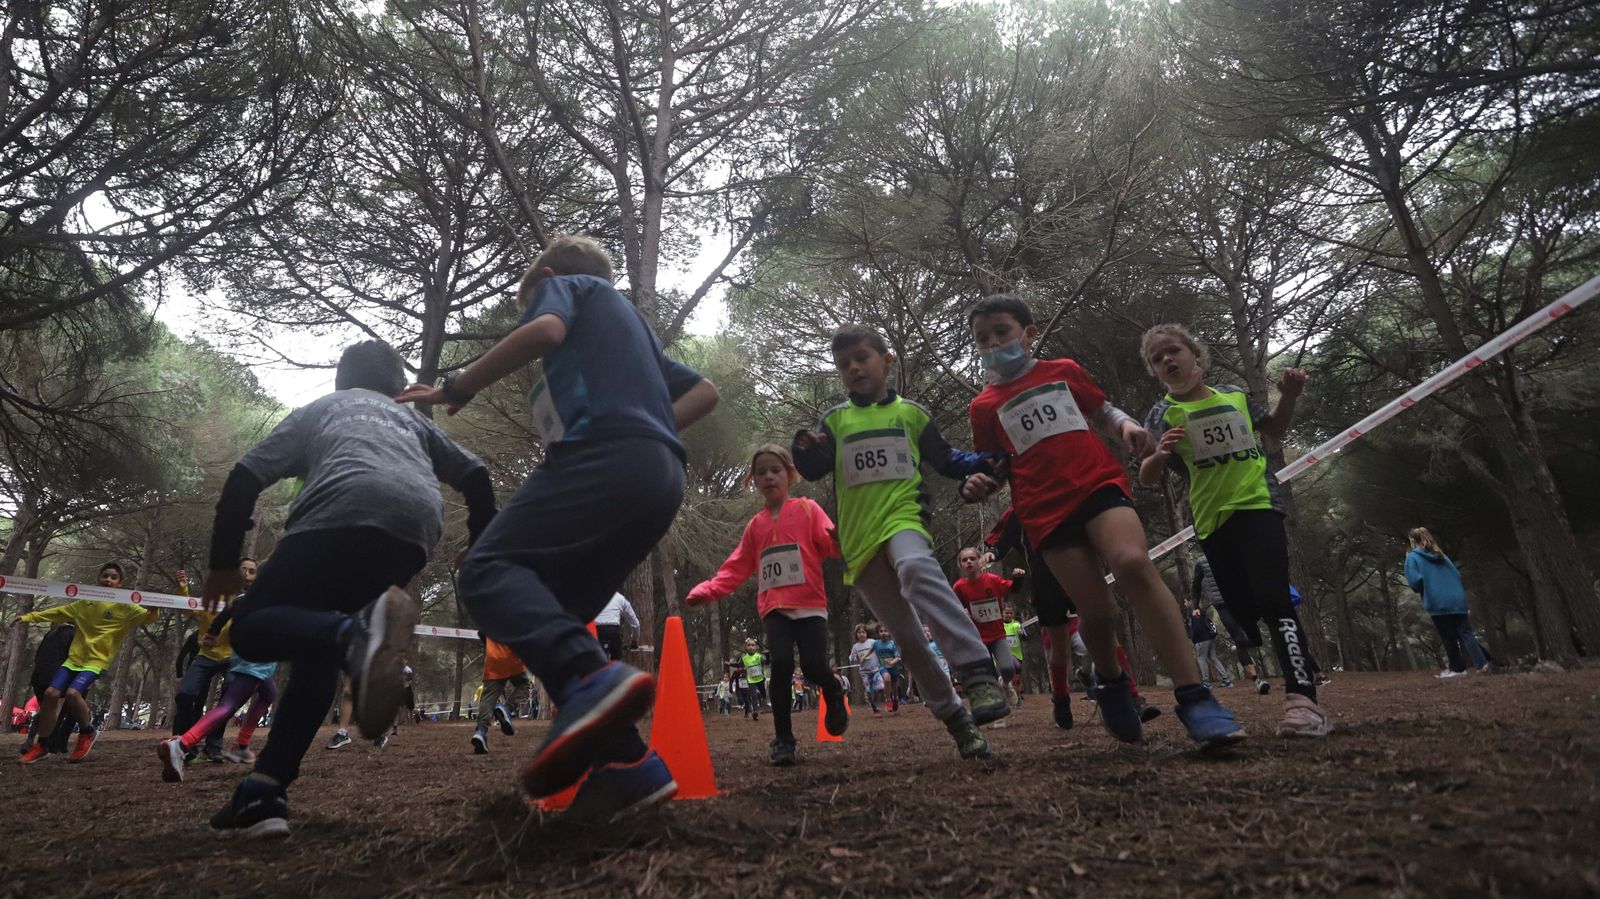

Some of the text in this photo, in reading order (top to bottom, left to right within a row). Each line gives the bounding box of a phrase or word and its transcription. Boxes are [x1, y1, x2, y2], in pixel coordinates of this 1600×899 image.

[1020, 404, 1057, 432] 619
[1203, 423, 1234, 445] 531
[854, 448, 888, 471] 685
[762, 561, 782, 581] 670
[978, 608, 992, 618] 511
